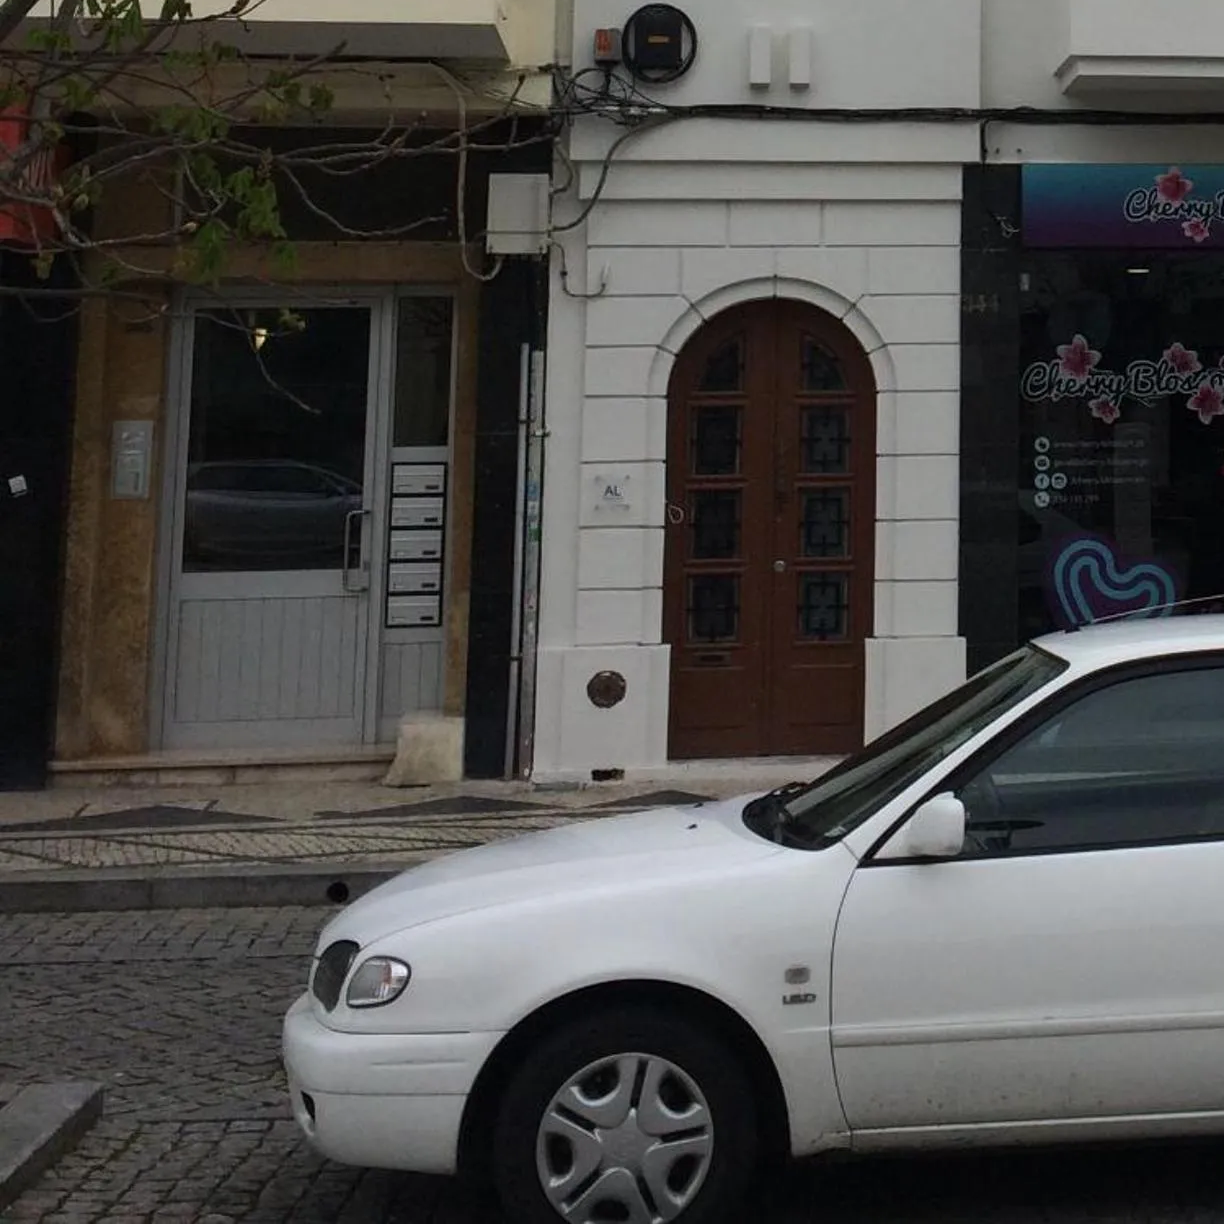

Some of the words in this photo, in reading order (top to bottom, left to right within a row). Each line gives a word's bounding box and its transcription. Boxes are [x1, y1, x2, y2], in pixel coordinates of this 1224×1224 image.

[1124, 186, 1216, 228] Cherry
[1021, 360, 1132, 405] Cherry
[604, 485, 621, 497] AL
